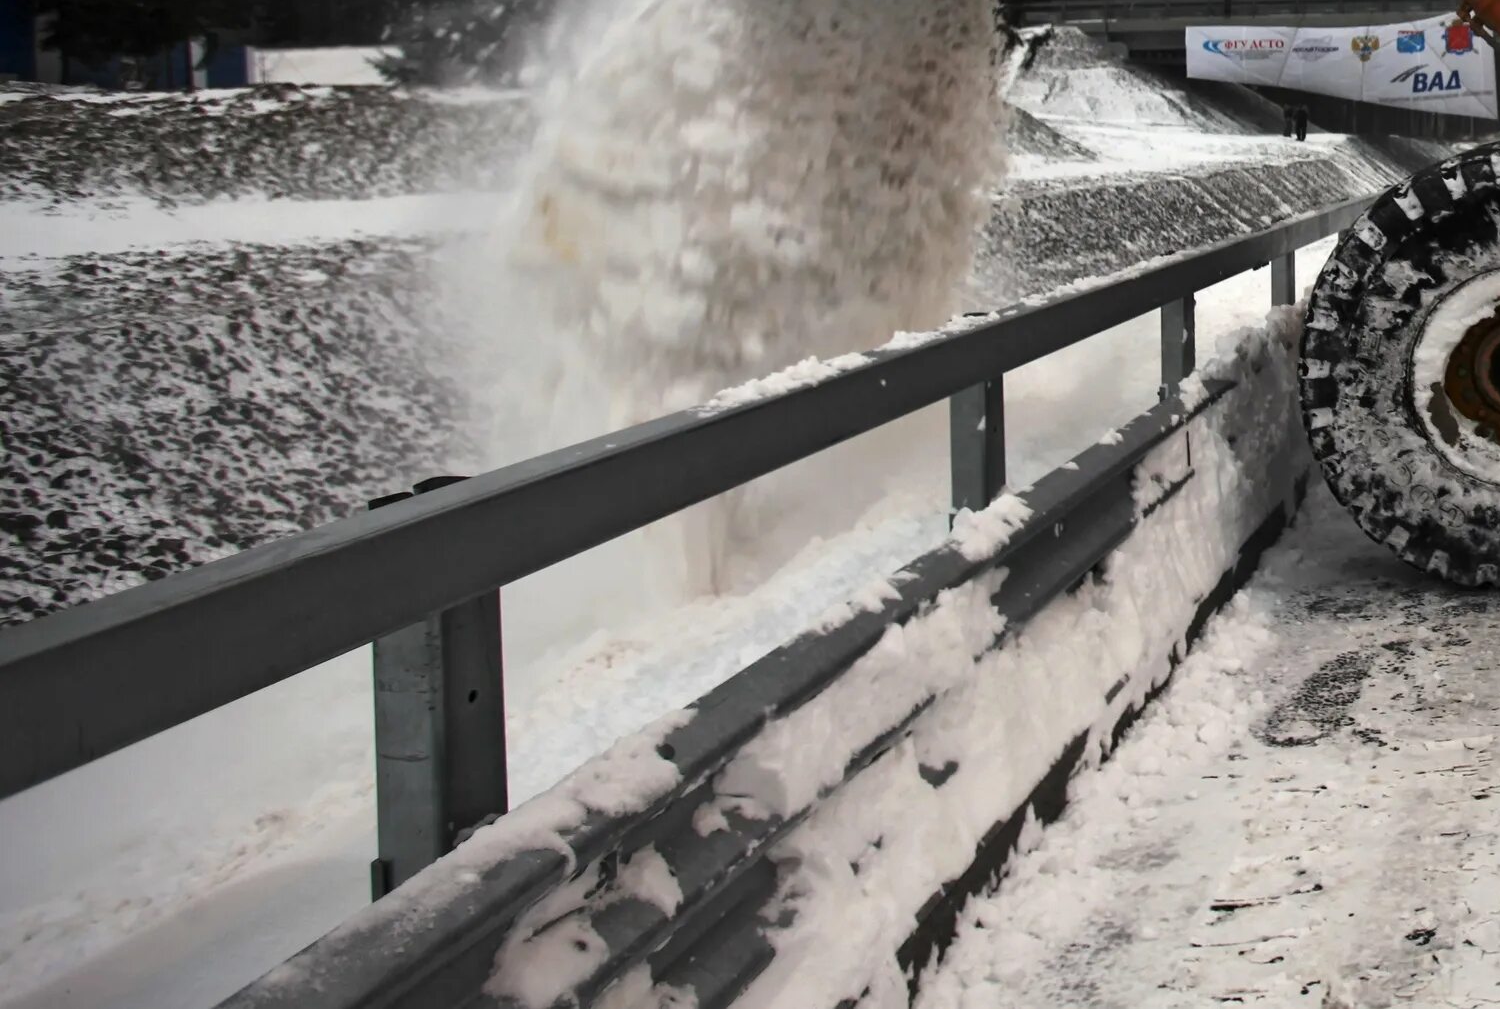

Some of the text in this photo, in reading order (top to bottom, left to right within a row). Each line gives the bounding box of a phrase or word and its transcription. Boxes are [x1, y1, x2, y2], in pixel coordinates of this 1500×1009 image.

[1224, 39, 1284, 49] ФГУ АСТО
[1412, 70, 1462, 93] ВАД
